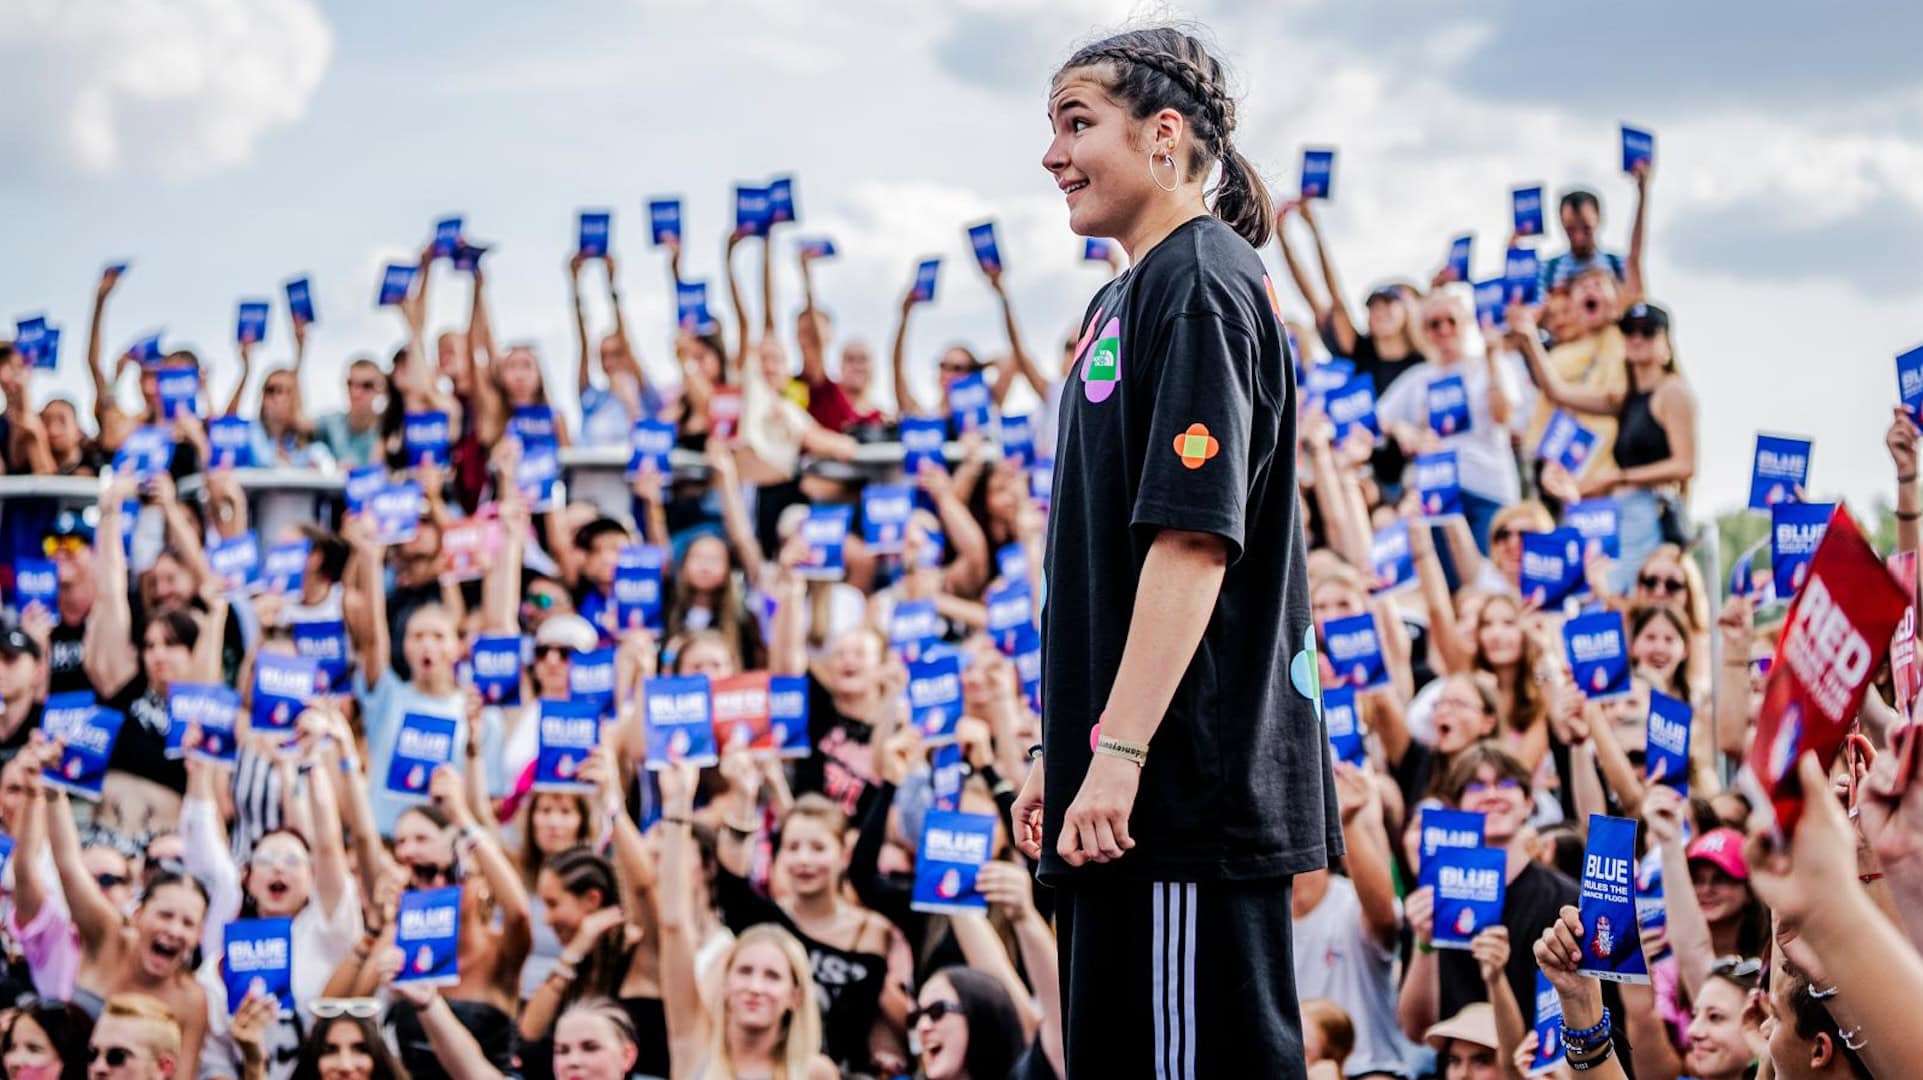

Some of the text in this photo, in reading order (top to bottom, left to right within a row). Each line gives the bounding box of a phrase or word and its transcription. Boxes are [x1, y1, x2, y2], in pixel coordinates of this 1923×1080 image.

[1758, 451, 1806, 473] BLUE
[1797, 572, 1871, 688] RED
[926, 829, 987, 853] BLUE
[1439, 866, 1499, 889] BLUE
[1586, 854, 1628, 884] BLUE
[1583, 890, 1628, 904] DANCE FLOOR
[1584, 880, 1628, 896] RULES THE
[228, 938, 287, 961] BLUE
